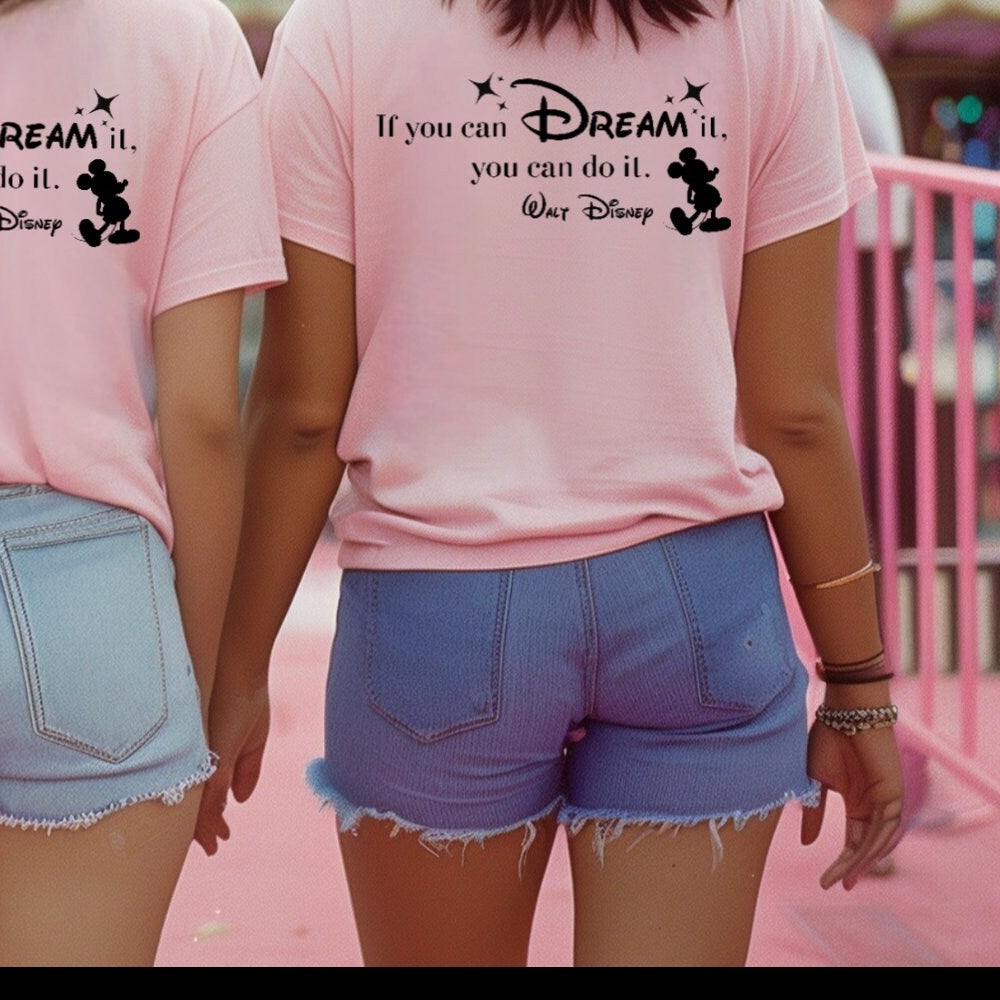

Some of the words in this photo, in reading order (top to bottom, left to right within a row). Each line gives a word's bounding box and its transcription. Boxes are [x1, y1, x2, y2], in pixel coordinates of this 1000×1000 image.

[110, 126, 137, 153] it,
[376, 113, 399, 138] If
[404, 121, 452, 146] you
[460, 121, 507, 139] can
[700, 114, 728, 142] it,
[33, 166, 60, 190] it.
[470, 161, 518, 186] you
[527, 161, 573, 179] can
[582, 154, 616, 178] do
[624, 154, 651, 178] it.
